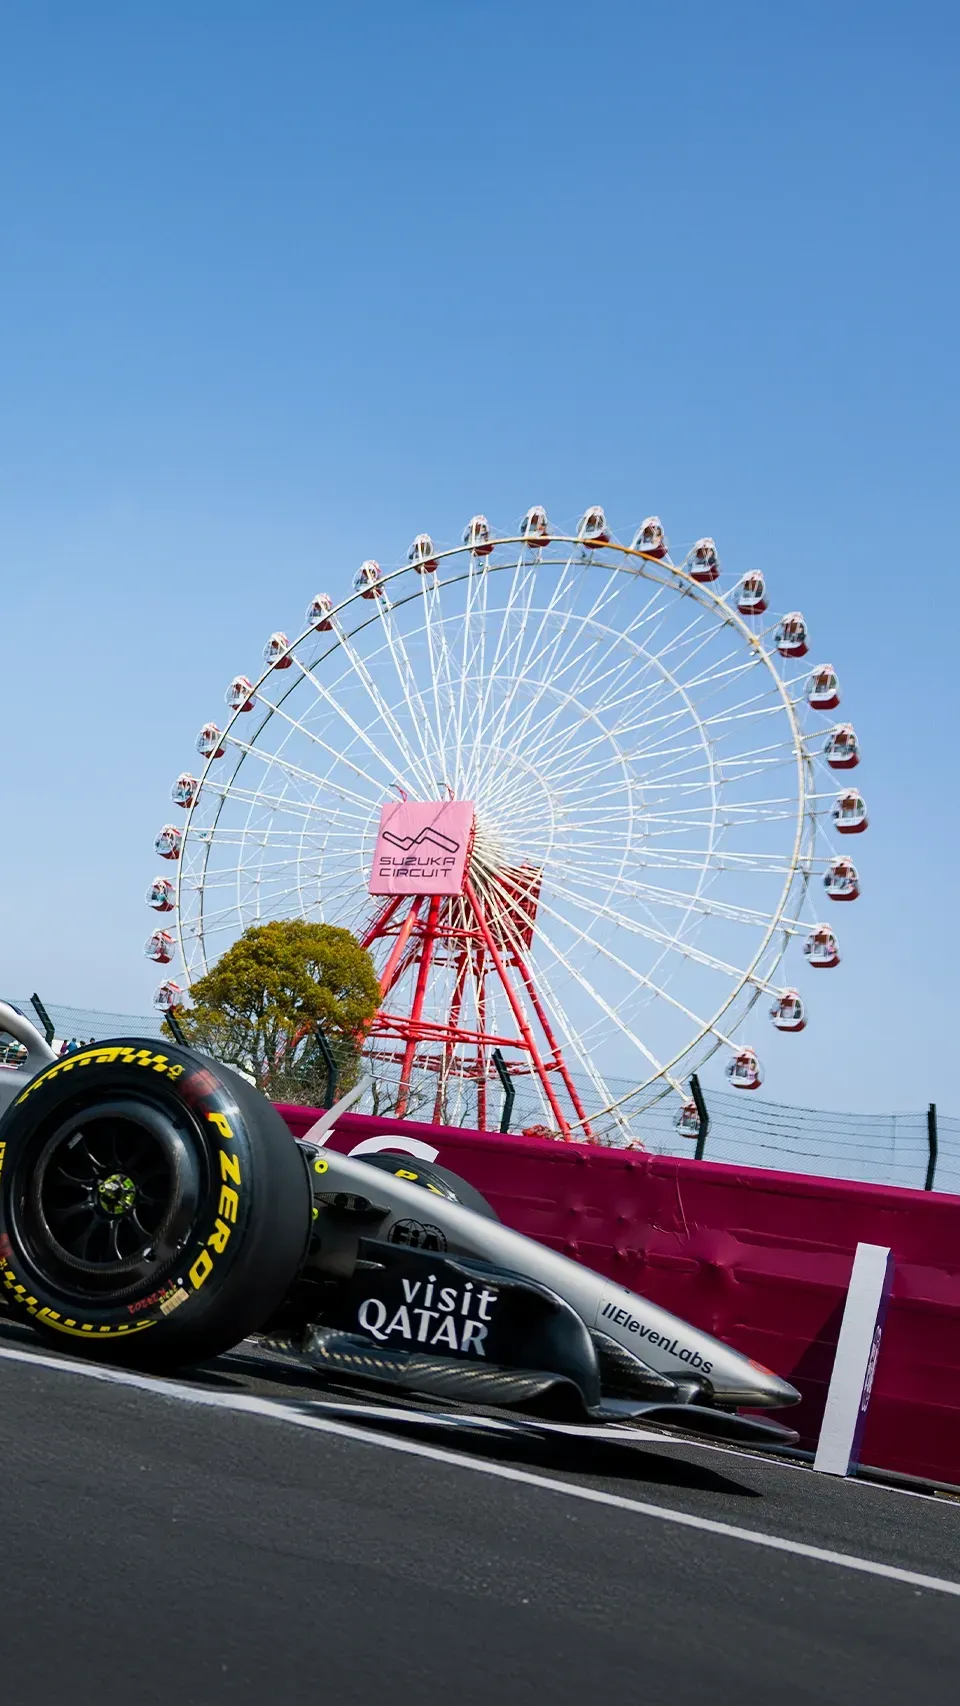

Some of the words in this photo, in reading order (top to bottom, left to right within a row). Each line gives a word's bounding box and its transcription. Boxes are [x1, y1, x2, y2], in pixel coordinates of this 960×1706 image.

[379, 868, 452, 877] CIRCUIT
[380, 857, 456, 866] SUZUKA
[206, 1112, 234, 1139] P
[189, 1150, 242, 1289] ZERO
[402, 1274, 498, 1321] visit
[357, 1298, 489, 1357] QATAR
